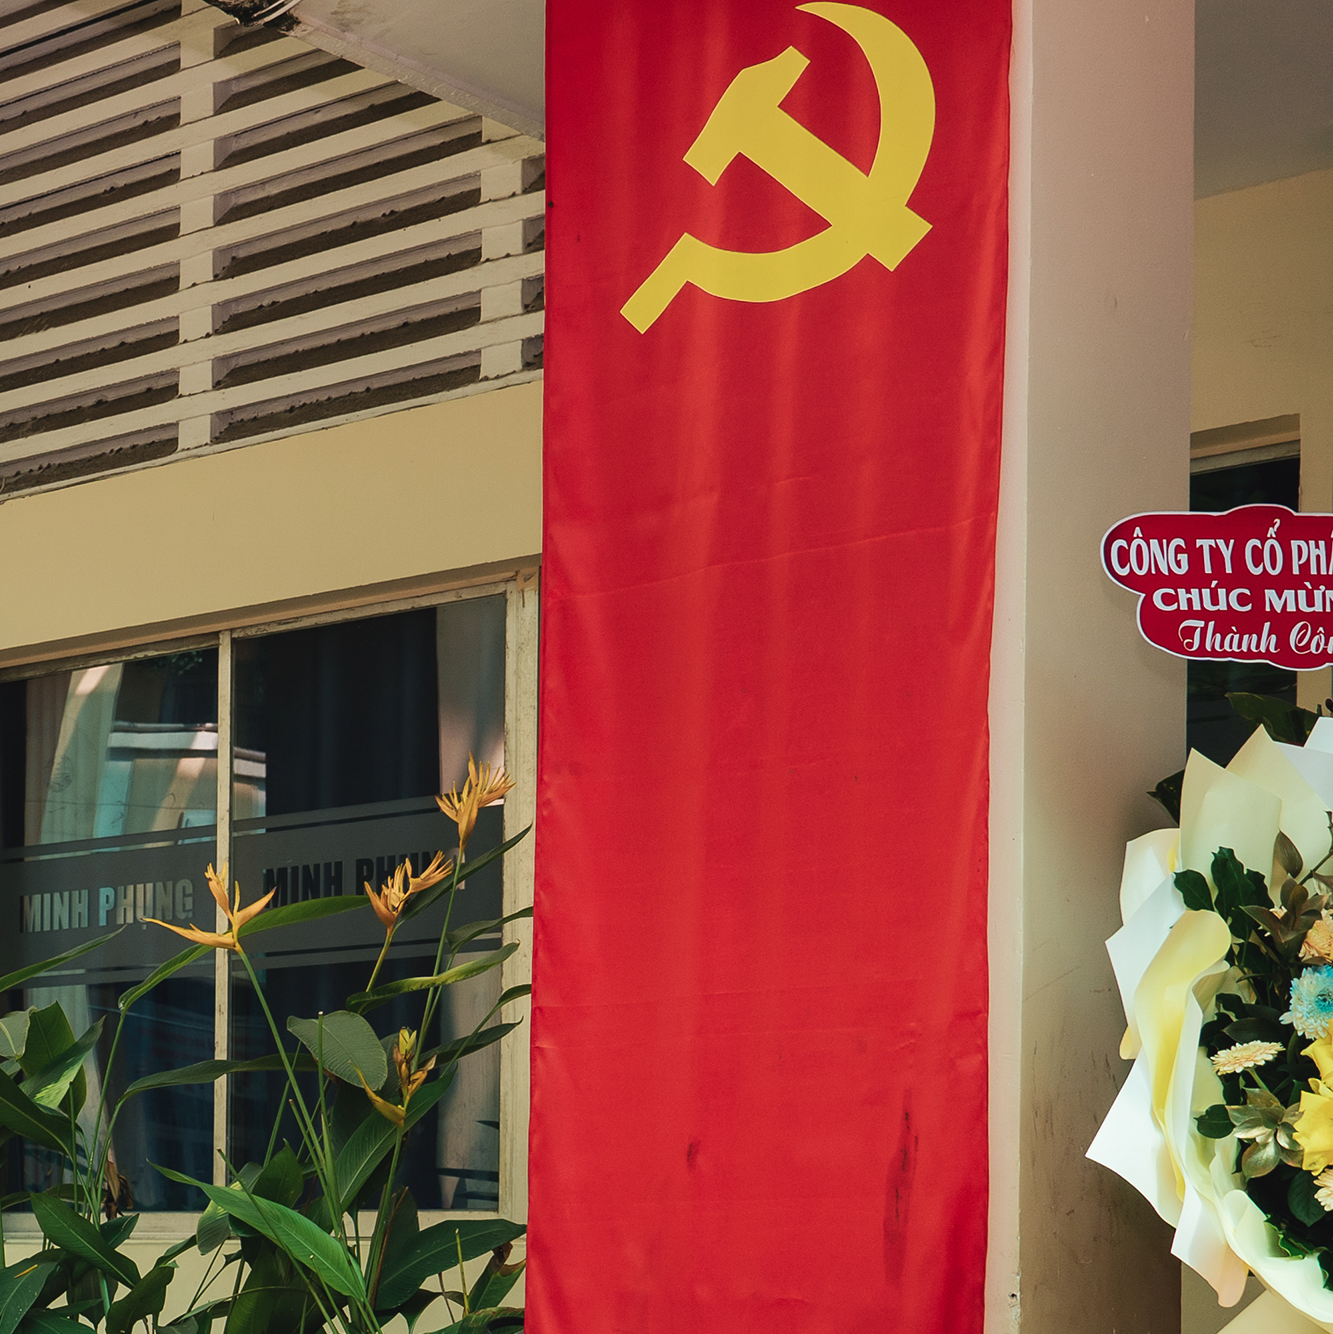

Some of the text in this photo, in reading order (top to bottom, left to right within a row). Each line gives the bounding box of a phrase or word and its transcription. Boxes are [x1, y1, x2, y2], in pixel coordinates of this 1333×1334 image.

[1110, 518, 1333, 576] CÔNG TY CỔ PH
[1152, 580, 1253, 612] CHÚC
[1177, 619, 1281, 653] Thành
[19, 878, 194, 934] MINH PHỤNG
